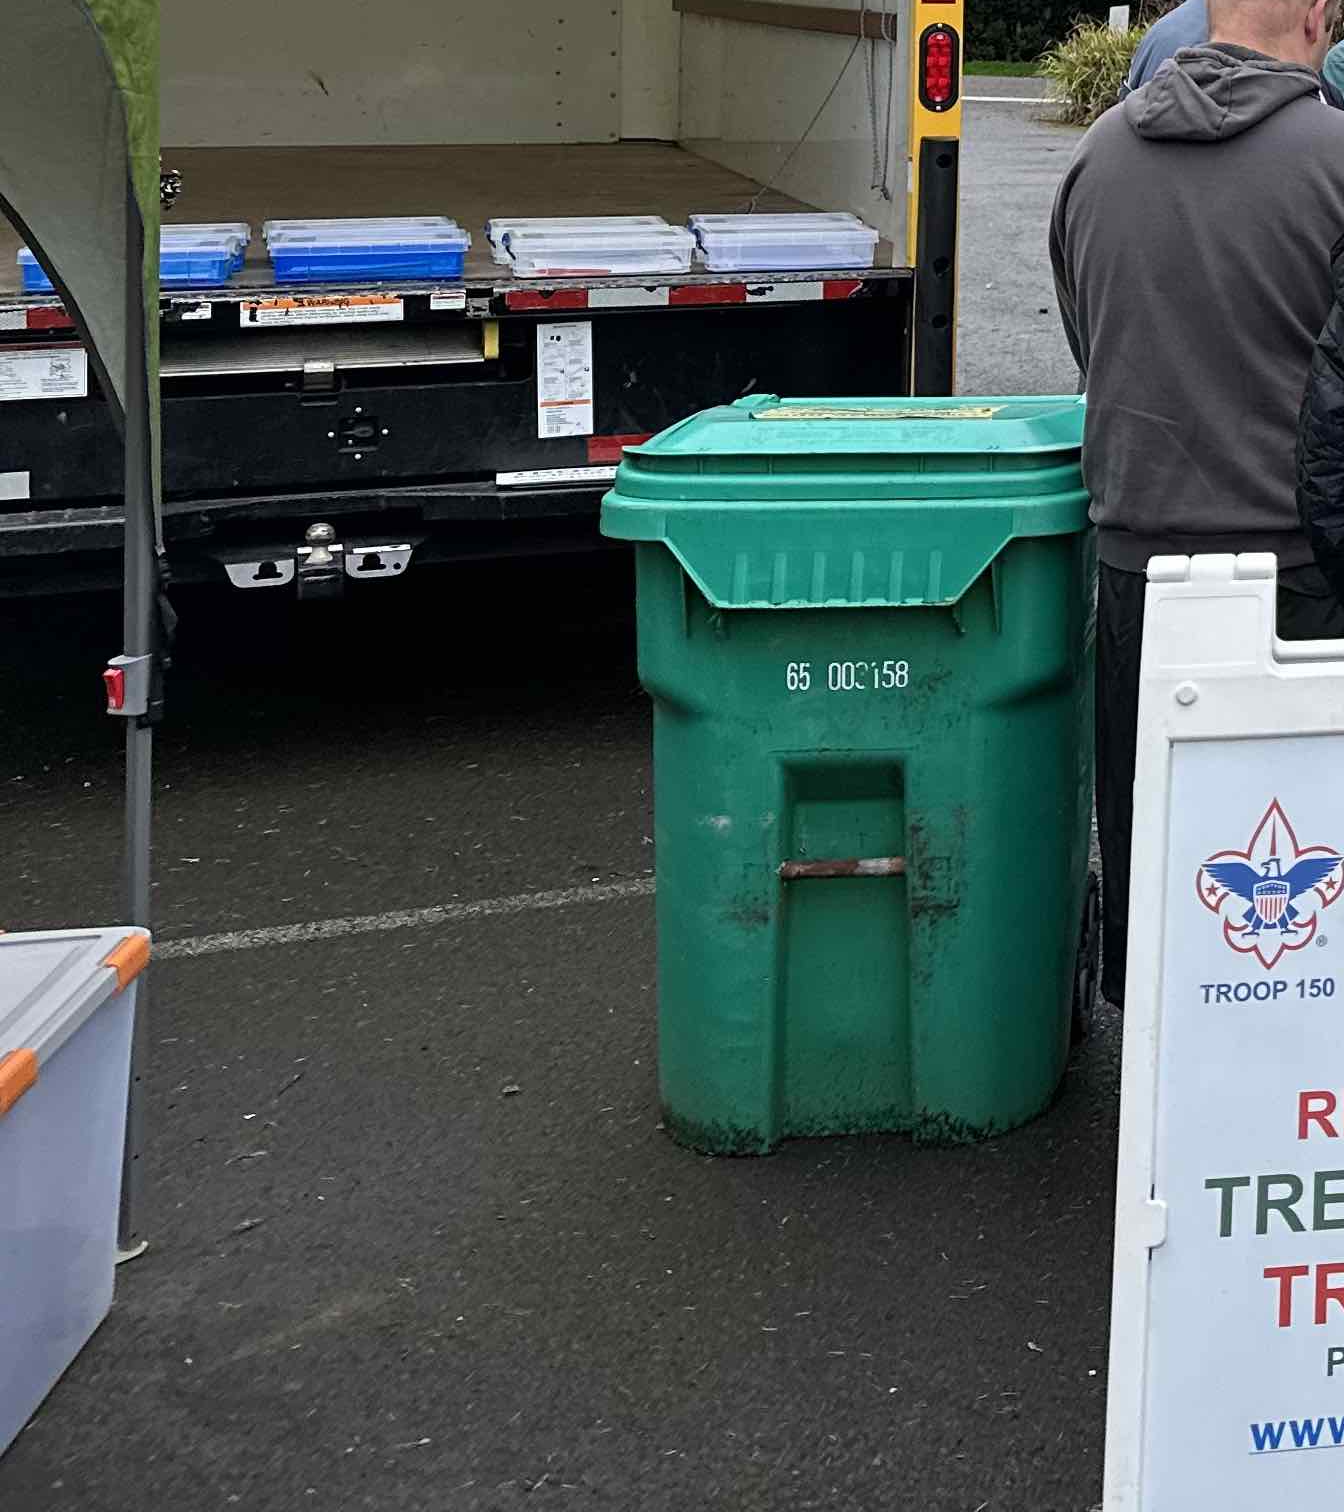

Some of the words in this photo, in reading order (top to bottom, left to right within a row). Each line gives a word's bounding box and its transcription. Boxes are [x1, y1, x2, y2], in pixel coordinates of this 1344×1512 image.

[786, 662, 811, 691] 65
[1200, 980, 1288, 1004] TROOP
[1295, 976, 1336, 1000] 150
